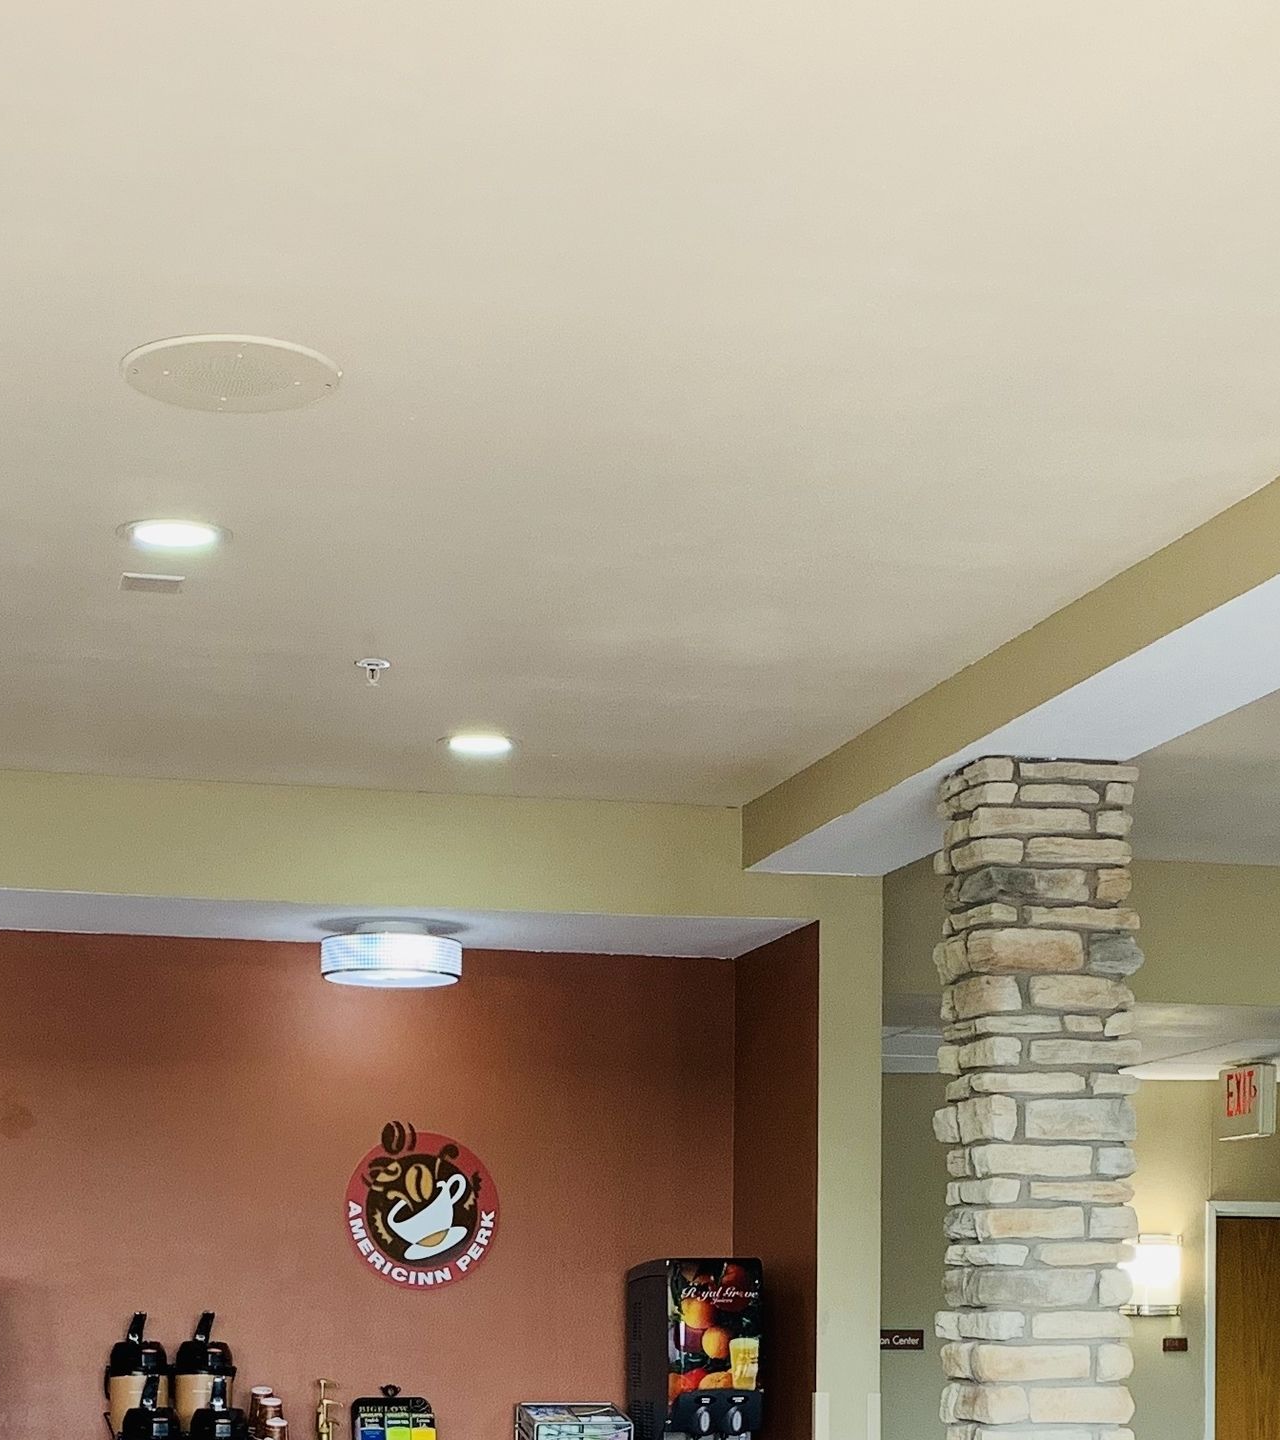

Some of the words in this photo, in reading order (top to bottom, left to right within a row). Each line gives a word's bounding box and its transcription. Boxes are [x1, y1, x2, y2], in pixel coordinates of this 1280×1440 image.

[1226, 1069, 1254, 1118] EXIT
[348, 1200, 453, 1286] AMERICINN
[455, 1210, 496, 1273] PERK
[892, 1334, 920, 1346] Center
[358, 1405, 409, 1413] BIGELOW
